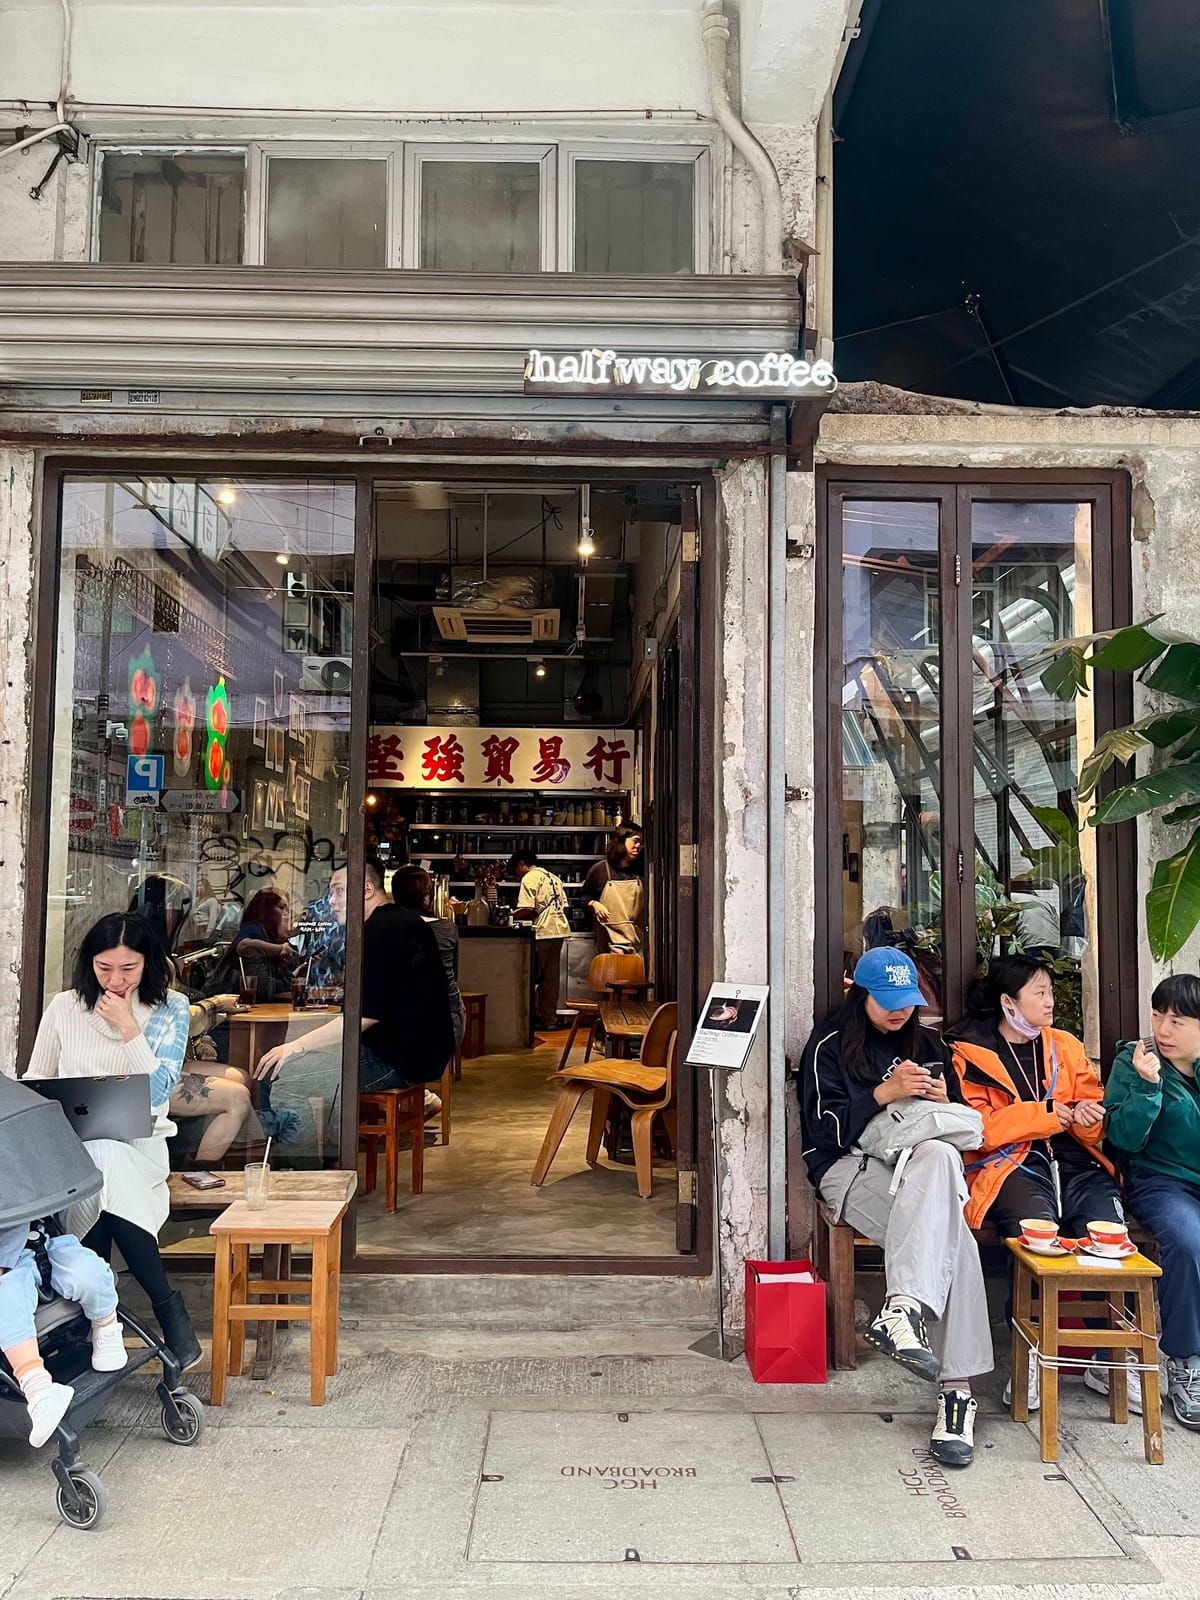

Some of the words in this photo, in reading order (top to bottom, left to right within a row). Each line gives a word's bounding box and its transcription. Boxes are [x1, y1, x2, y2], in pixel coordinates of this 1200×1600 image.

[530, 349, 700, 390] halfway
[714, 352, 834, 388] coffee
[368, 733, 631, 785] 堅強貿易行
[560, 1466, 697, 1477] BROADBAND
[603, 1478, 657, 1490] HGC
[898, 1468, 930, 1496] HGC
[911, 1448, 967, 1518] BROADBAND
